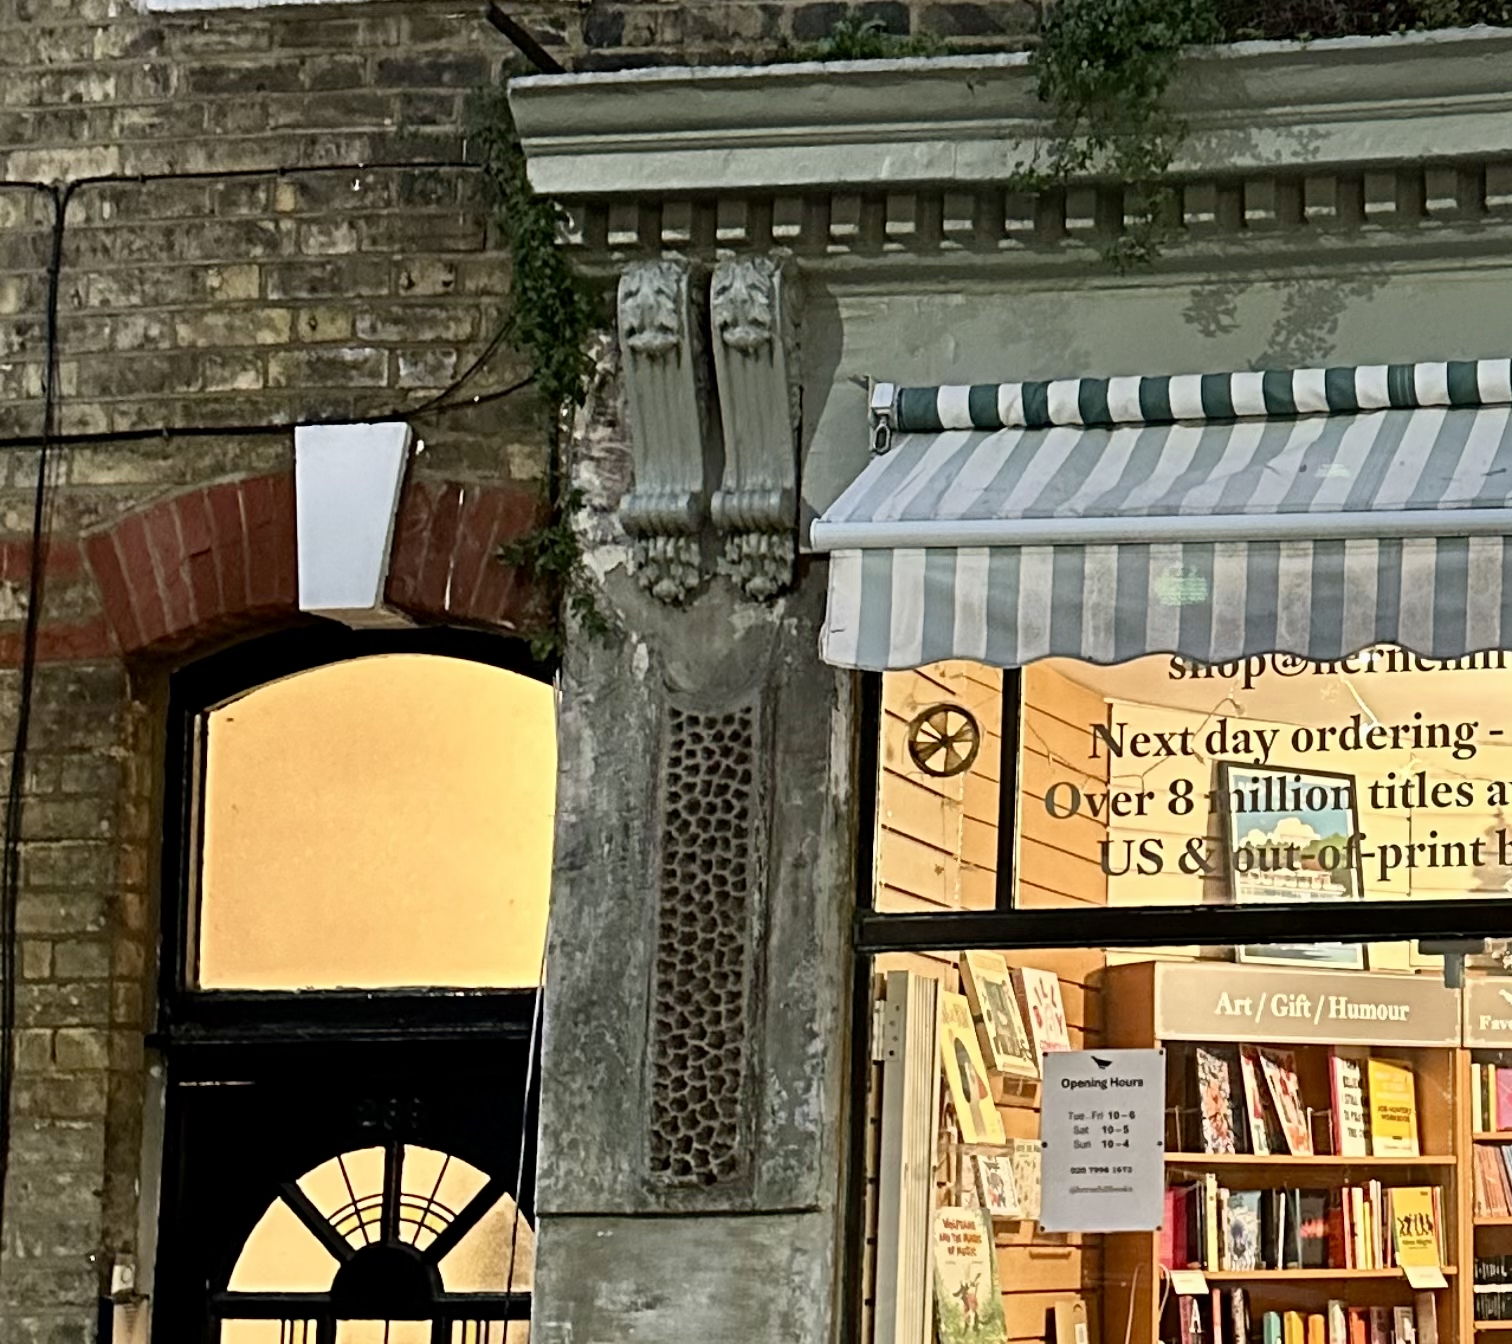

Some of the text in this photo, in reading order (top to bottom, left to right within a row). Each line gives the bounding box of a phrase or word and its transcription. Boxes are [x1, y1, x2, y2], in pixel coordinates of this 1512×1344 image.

[1089, 722, 1196, 759] Next
[1205, 718, 1277, 766] day
[1291, 712, 1480, 761] ordering
[1045, 780, 1156, 819] Over
[1166, 779, 1195, 816] 8
[1206, 774, 1353, 814] million
[1367, 770, 1475, 810] titles
[1099, 837, 1165, 876] US
[1177, 837, 1216, 876] &
[1232, 831, 1488, 883] out-of-print
[1214, 991, 1410, 1025] Art / Gift / Humour
[1060, 1076, 1144, 1091] Opening Hours
[1068, 1111, 1104, 1121] Tue Fri
[1073, 1125, 1090, 1135] Sat
[1073, 1140, 1092, 1150] Sun
